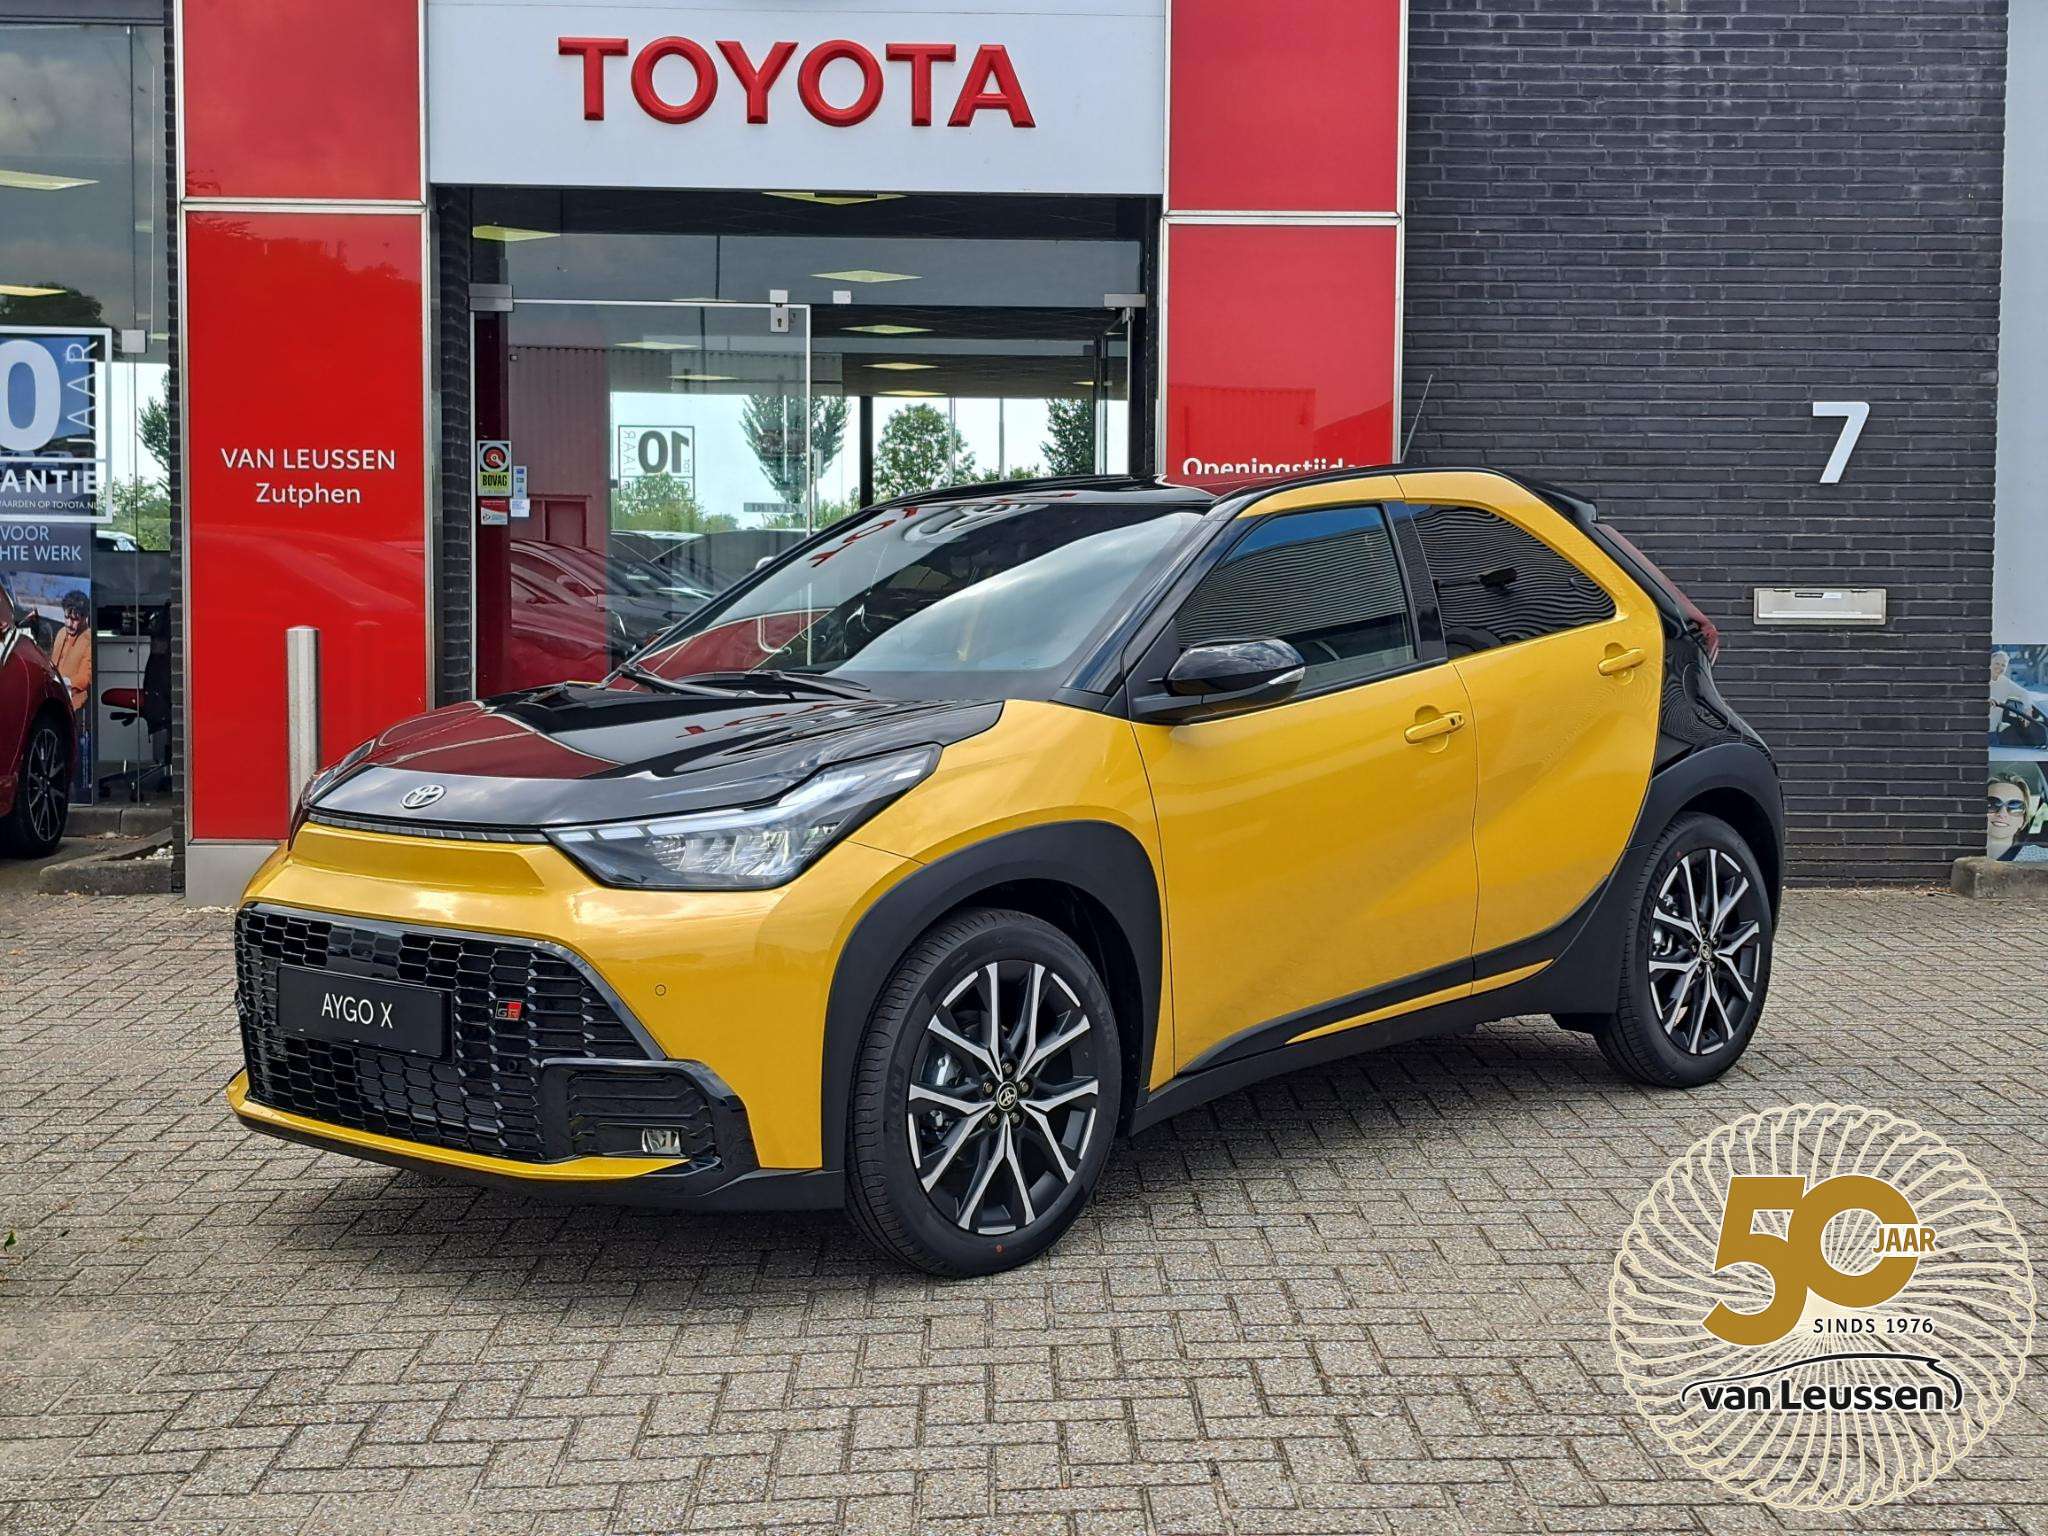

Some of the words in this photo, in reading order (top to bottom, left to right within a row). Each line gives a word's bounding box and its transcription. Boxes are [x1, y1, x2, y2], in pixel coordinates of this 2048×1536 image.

[558, 36, 1036, 128] TOYOTA
[66, 341, 98, 446] JAAR
[1812, 401, 1870, 484] 7
[221, 448, 275, 469] VAN
[283, 449, 396, 470] LEUSSEN
[482, 474, 508, 487] BOVAG
[38, 501, 50, 509] OP
[256, 482, 361, 508] Zutphen
[0, 525, 50, 541] VOOR
[34, 545, 82, 561] WERK
[321, 993, 374, 1025] AYGO
[380, 1002, 393, 1029] X
